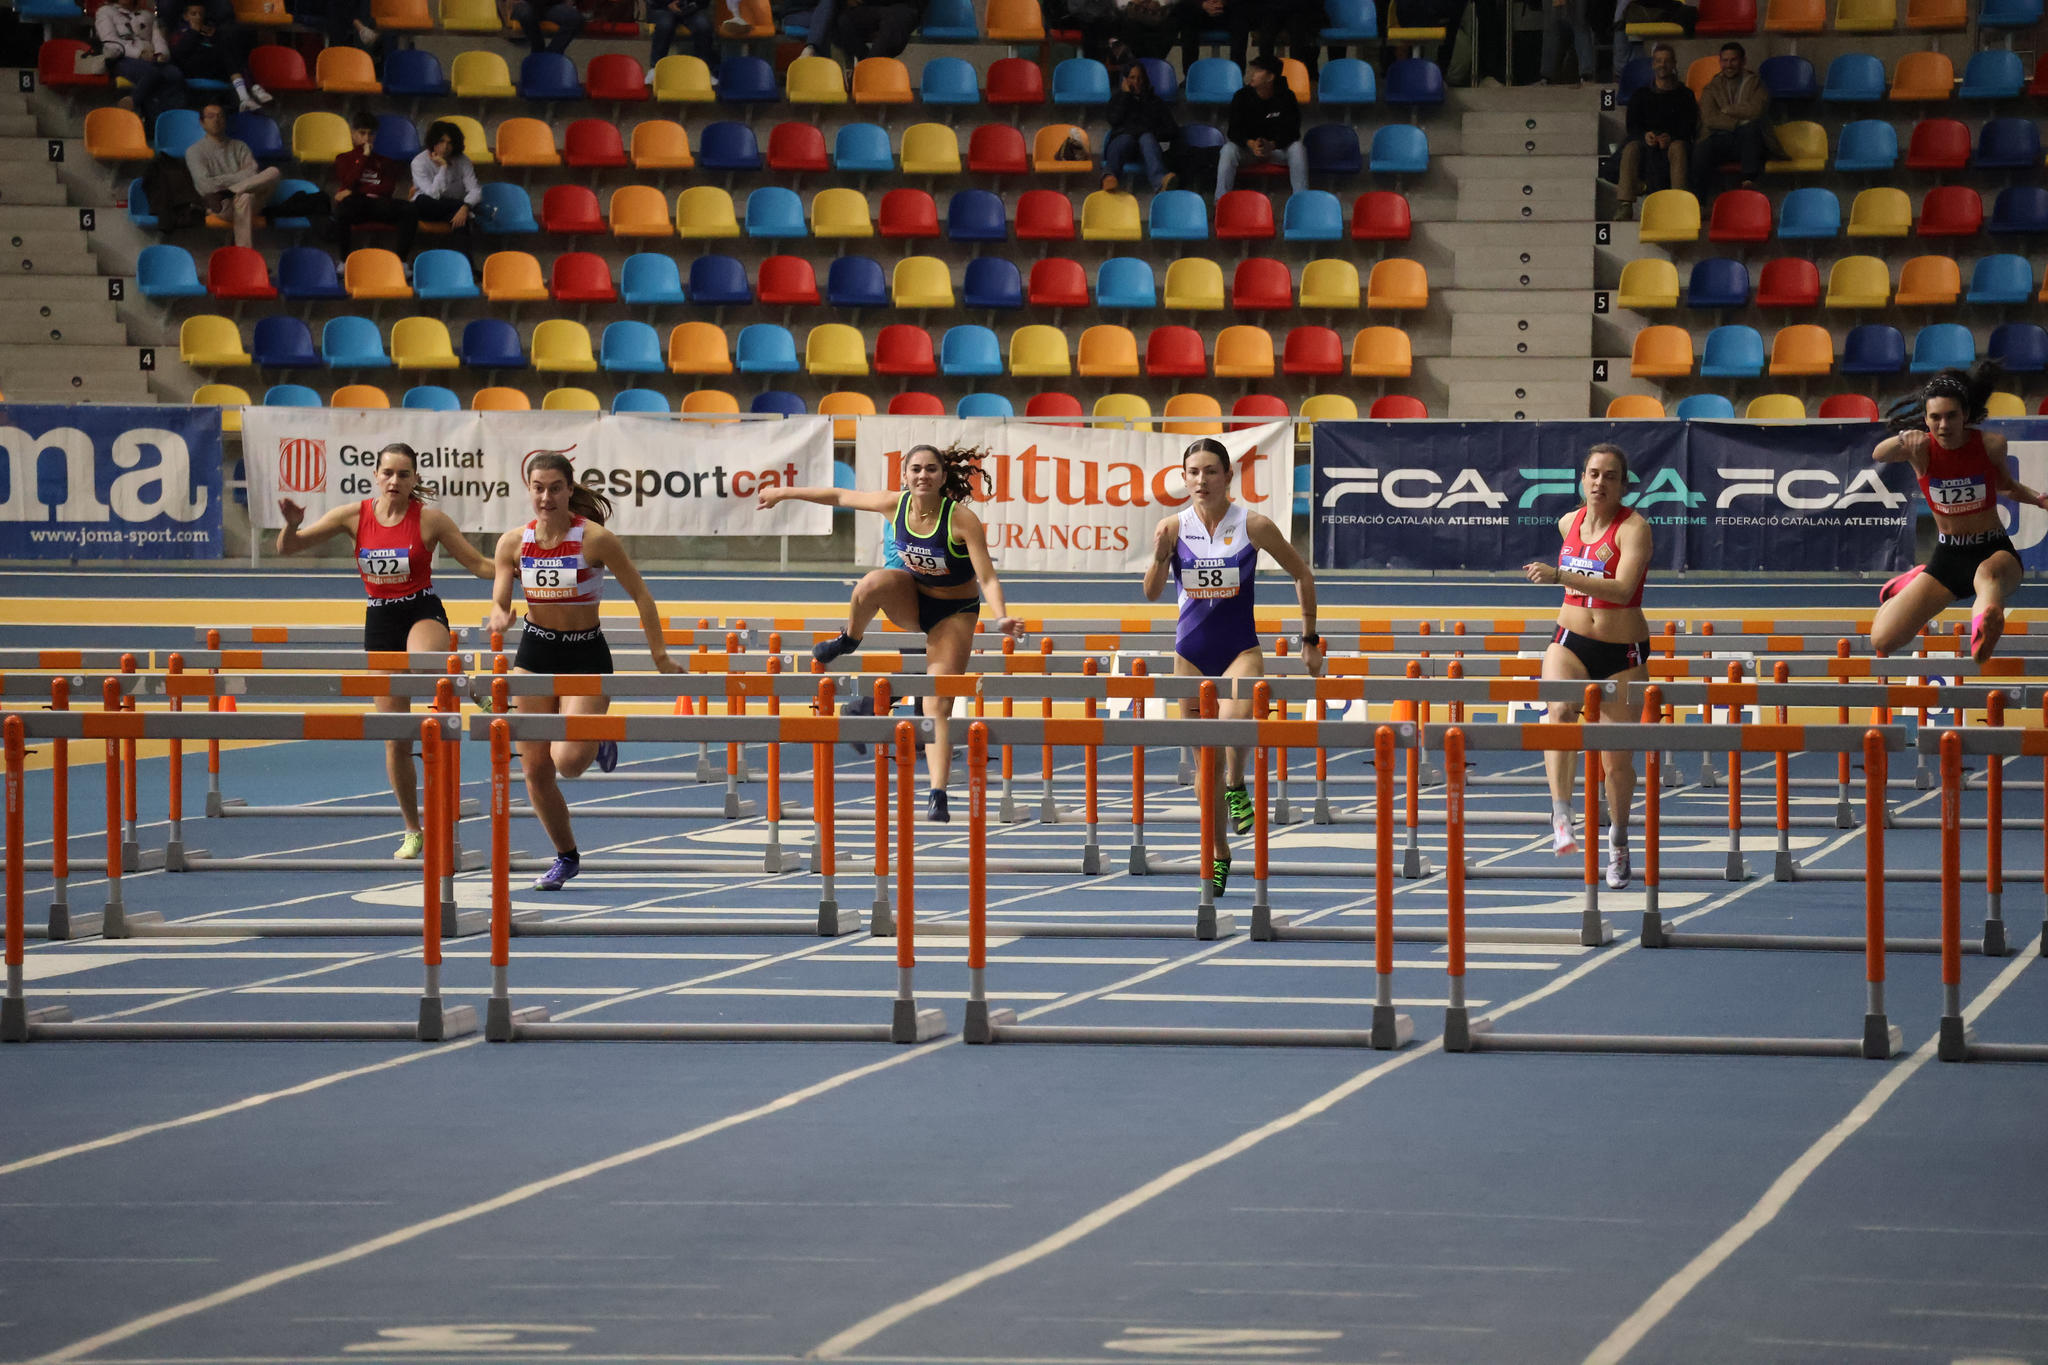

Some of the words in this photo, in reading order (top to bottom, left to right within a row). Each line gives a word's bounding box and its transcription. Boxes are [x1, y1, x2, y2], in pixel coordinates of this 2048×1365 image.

[22, 75, 31, 88] 8
[1604, 95, 1612, 107] 8
[52, 145, 60, 158] 7
[82, 214, 91, 227] 6
[1599, 228, 1607, 240] 6
[112, 283, 120, 296] 5
[1598, 297, 1605, 309] 5
[143, 353, 151, 366] 4
[1596, 365, 1604, 377] 4
[340, 445, 484, 469] Gealitat
[883, 444, 1269, 507] utuact
[340, 474, 372, 494] de
[581, 463, 798, 507] esportcat
[1322, 468, 1509, 508] FCA
[1716, 469, 1907, 509] FCA
[1939, 487, 1976, 504] 123
[1322, 515, 1384, 525] FEDERACIÓ
[1386, 517, 1445, 525] CATALANA
[1448, 517, 1510, 526] ATLETISME
[1518, 516, 1559, 526] FEDERA
[1715, 515, 1778, 526] FEDERACIÓ
[1781, 517, 1842, 526] CATALANA
[1844, 517, 1908, 526] ATLETISME
[30, 529, 210, 546] www.joma-sport.com
[982, 523, 1129, 551] URANCES
[366, 559, 401, 575] 122
[905, 553, 937, 570] 129
[536, 569, 560, 587] 63
[1198, 569, 1223, 588] 58
[527, 626, 556, 640] PRO
[562, 630, 595, 642] NIKE
